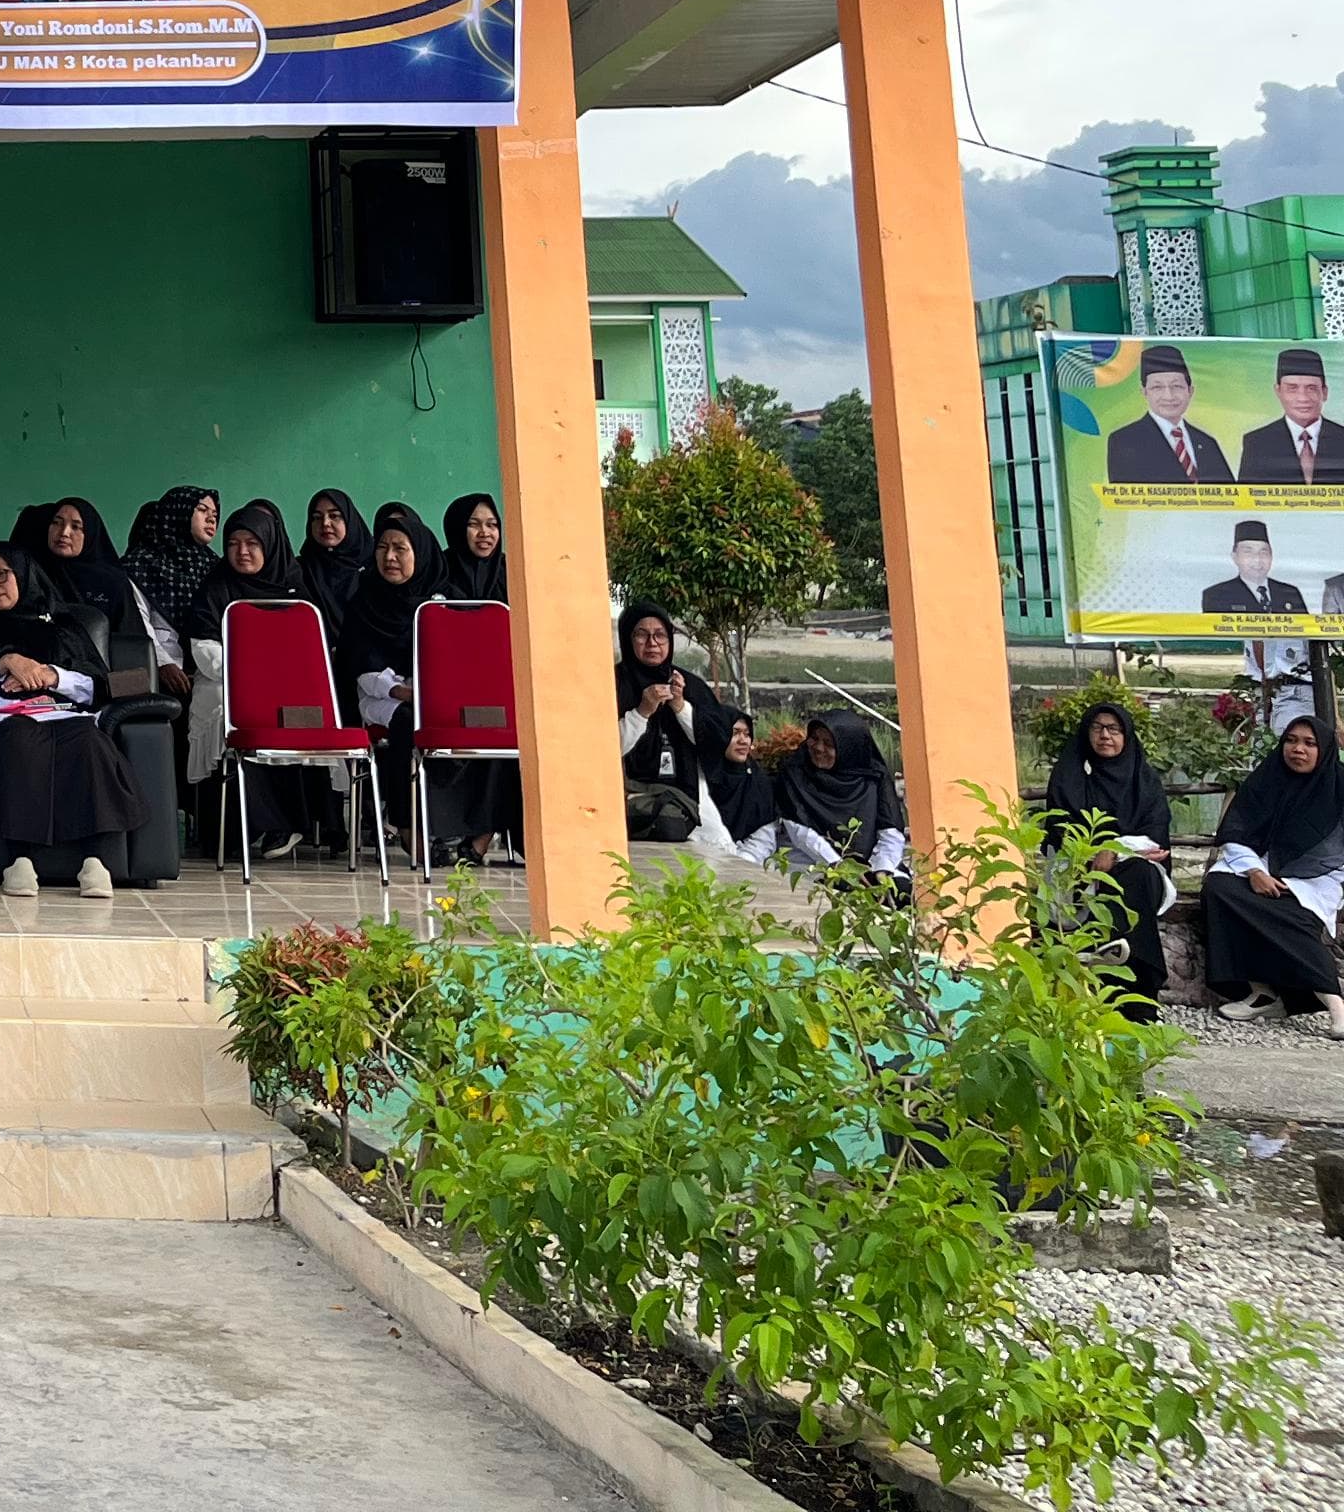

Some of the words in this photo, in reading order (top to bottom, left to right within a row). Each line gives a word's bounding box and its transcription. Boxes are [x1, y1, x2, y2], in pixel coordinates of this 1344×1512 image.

[0, 20, 44, 36] Yoni
[14, 55, 59, 70] MAN
[64, 55, 76, 69] 3
[82, 54, 128, 70] Kota
[133, 53, 237, 71] pekanbaru
